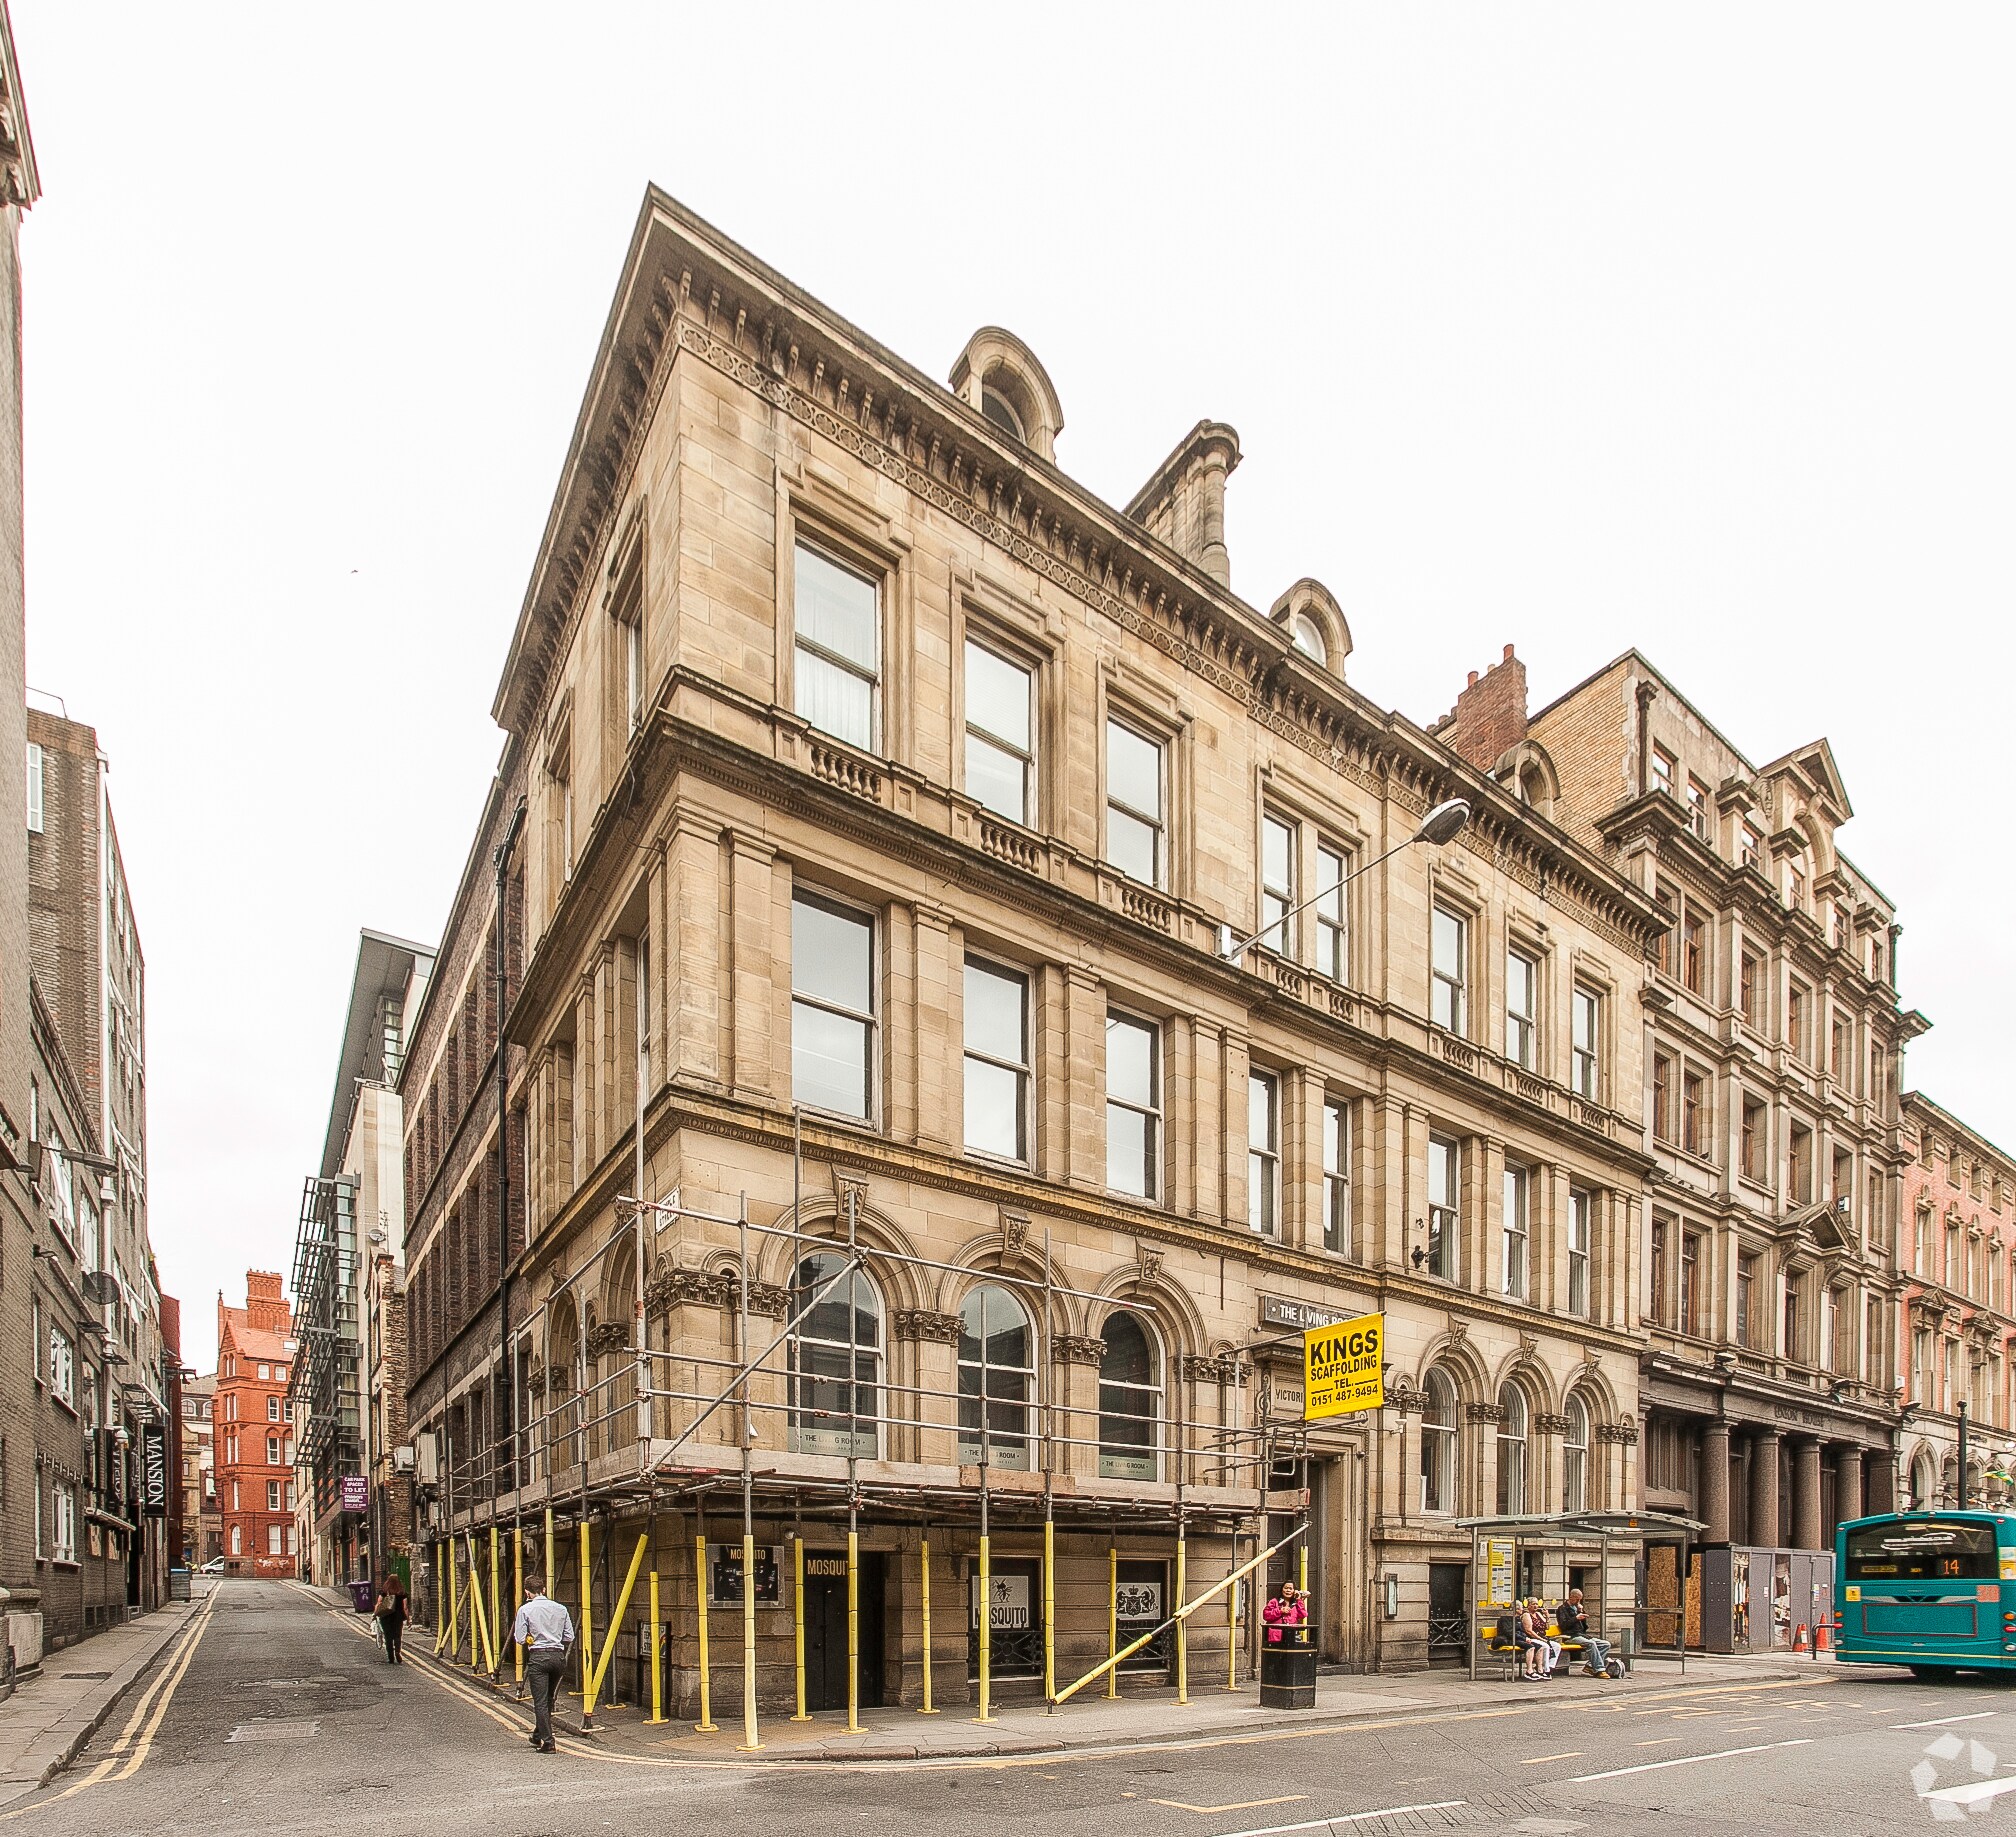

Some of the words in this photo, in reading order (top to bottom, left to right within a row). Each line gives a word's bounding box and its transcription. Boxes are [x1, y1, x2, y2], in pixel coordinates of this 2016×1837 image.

[1280, 1305, 1298, 1320] THE
[1299, 1309, 1329, 1327] LVING
[1310, 1329, 1379, 1366] KINGS
[1310, 1354, 1378, 1382] SCAFFOLDING
[1333, 1378, 1354, 1390] TEL.
[1275, 1388, 1304, 1404] VICTORI
[1311, 1394, 1333, 1406] 0151
[1335, 1384, 1379, 1402] 487-9494
[805, 1434, 817, 1442] THE
[841, 1437, 861, 1446] ROM
[146, 1434, 164, 1506] MANSION
[807, 1559, 849, 1576] MOSQUIT
[1943, 1559, 1960, 1575] 14
[974, 1606, 1027, 1626] MSQUITO
